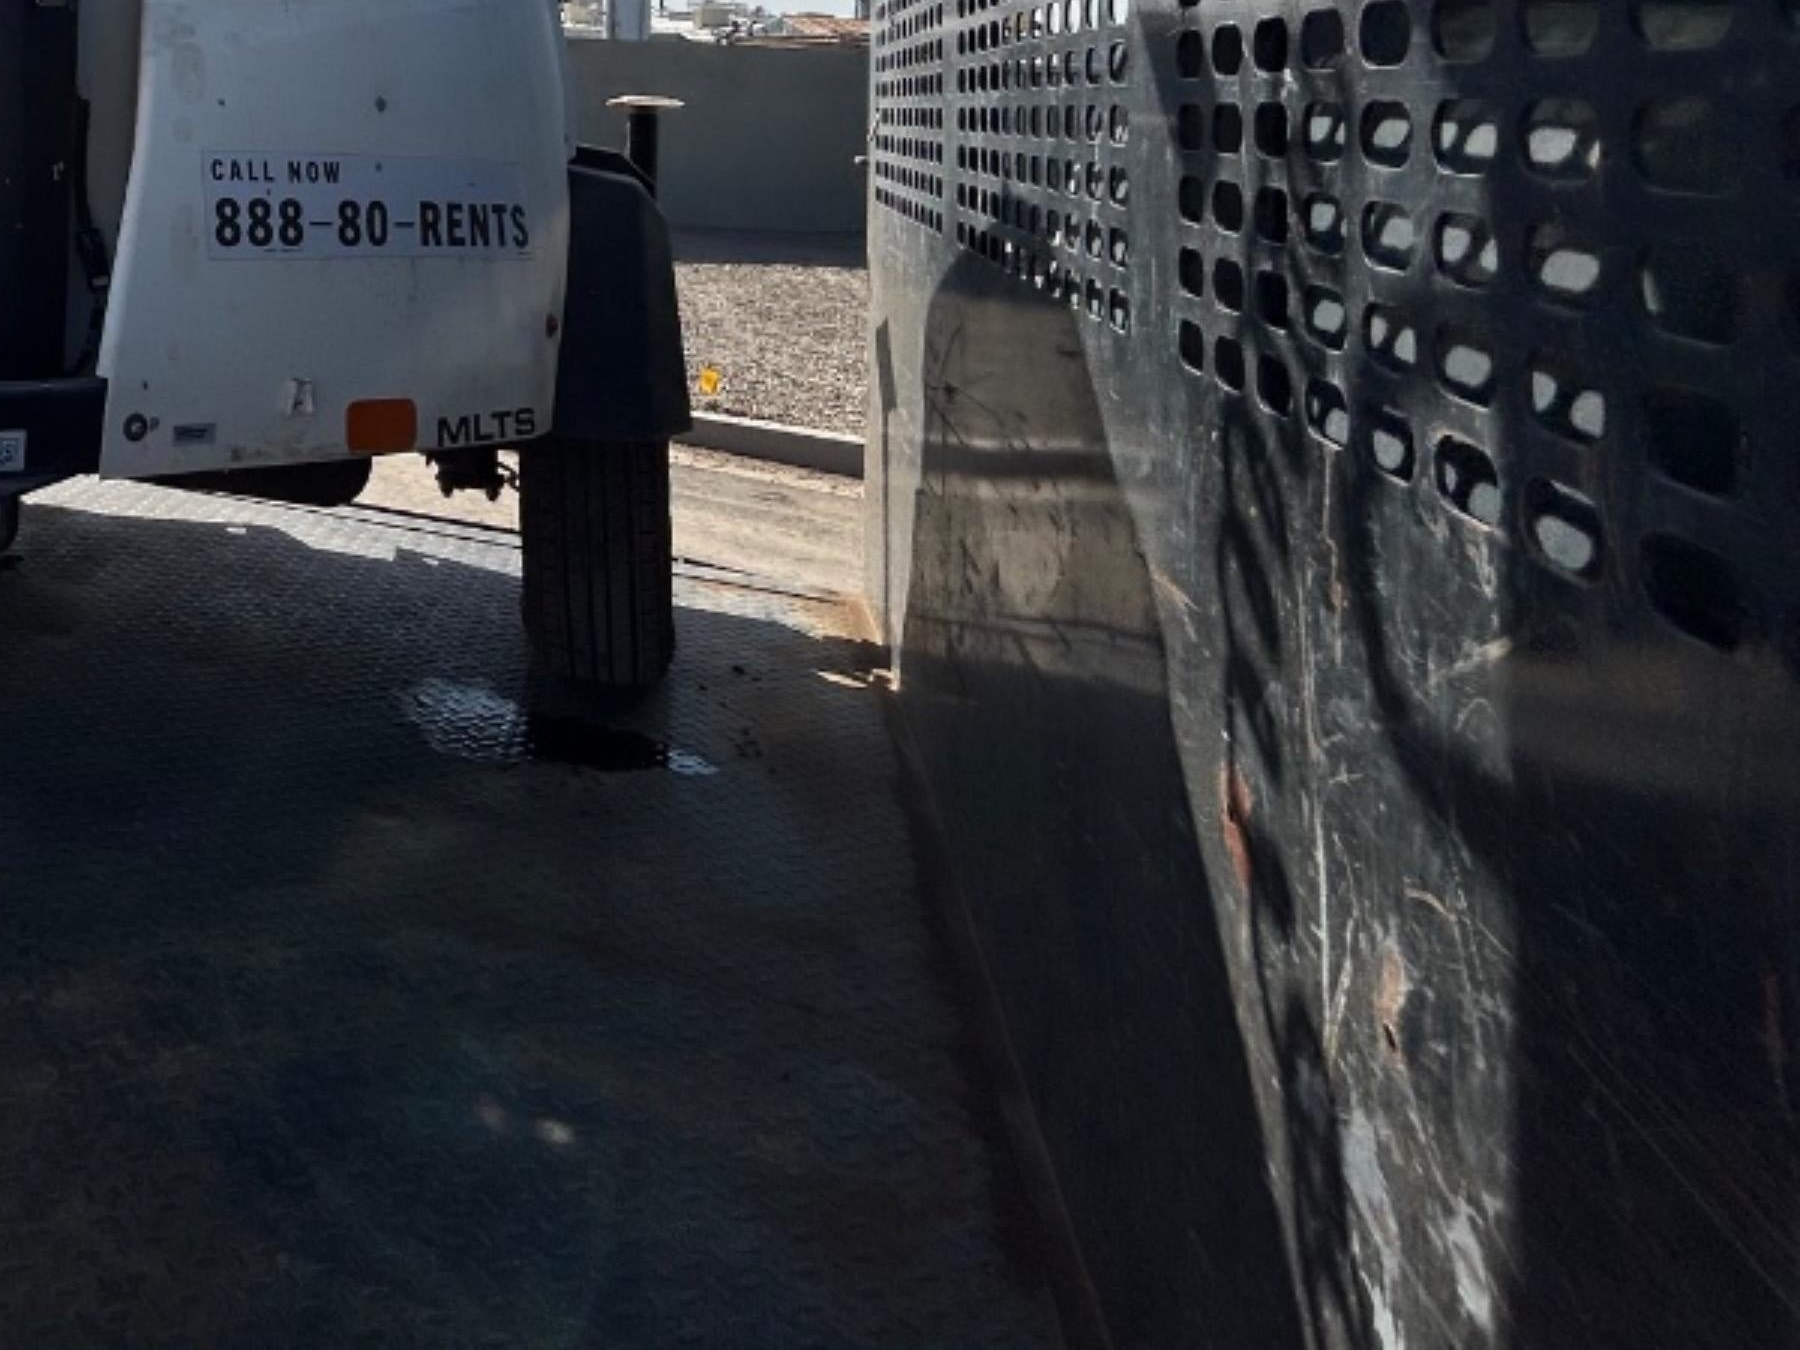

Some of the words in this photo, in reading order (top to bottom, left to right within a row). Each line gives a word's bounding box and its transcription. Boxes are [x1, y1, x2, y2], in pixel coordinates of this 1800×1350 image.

[211, 159, 275, 181] CALL
[288, 161, 339, 183] NOW
[215, 198, 528, 247] 888-80-RENTS
[437, 407, 535, 448] MLTS
